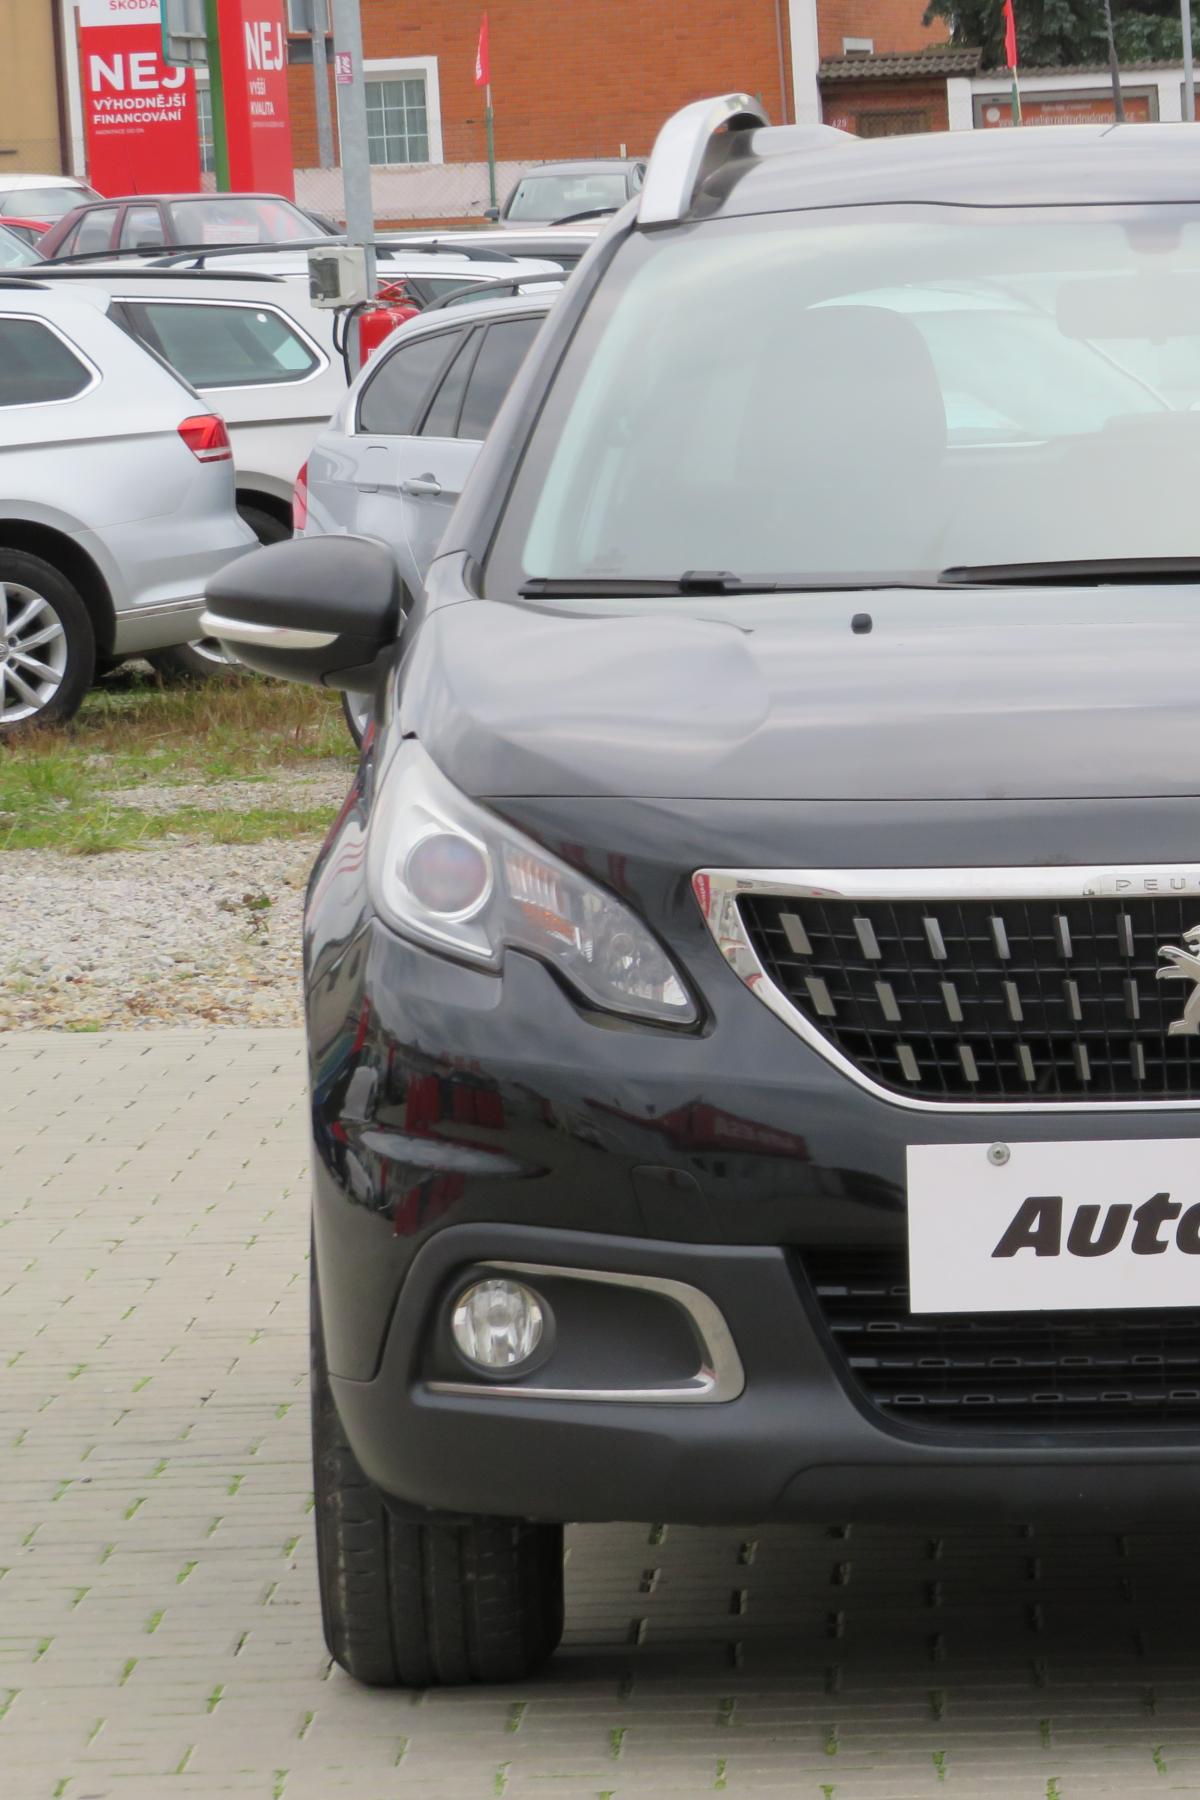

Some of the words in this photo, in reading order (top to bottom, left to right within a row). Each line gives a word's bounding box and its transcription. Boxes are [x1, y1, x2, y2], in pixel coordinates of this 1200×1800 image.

[244, 21, 284, 71] NEJ
[89, 51, 186, 92] NEJ
[93, 93, 187, 111] VÝHODNĚJŠÍ
[93, 109, 182, 124] FINANCOVÁNÍ
